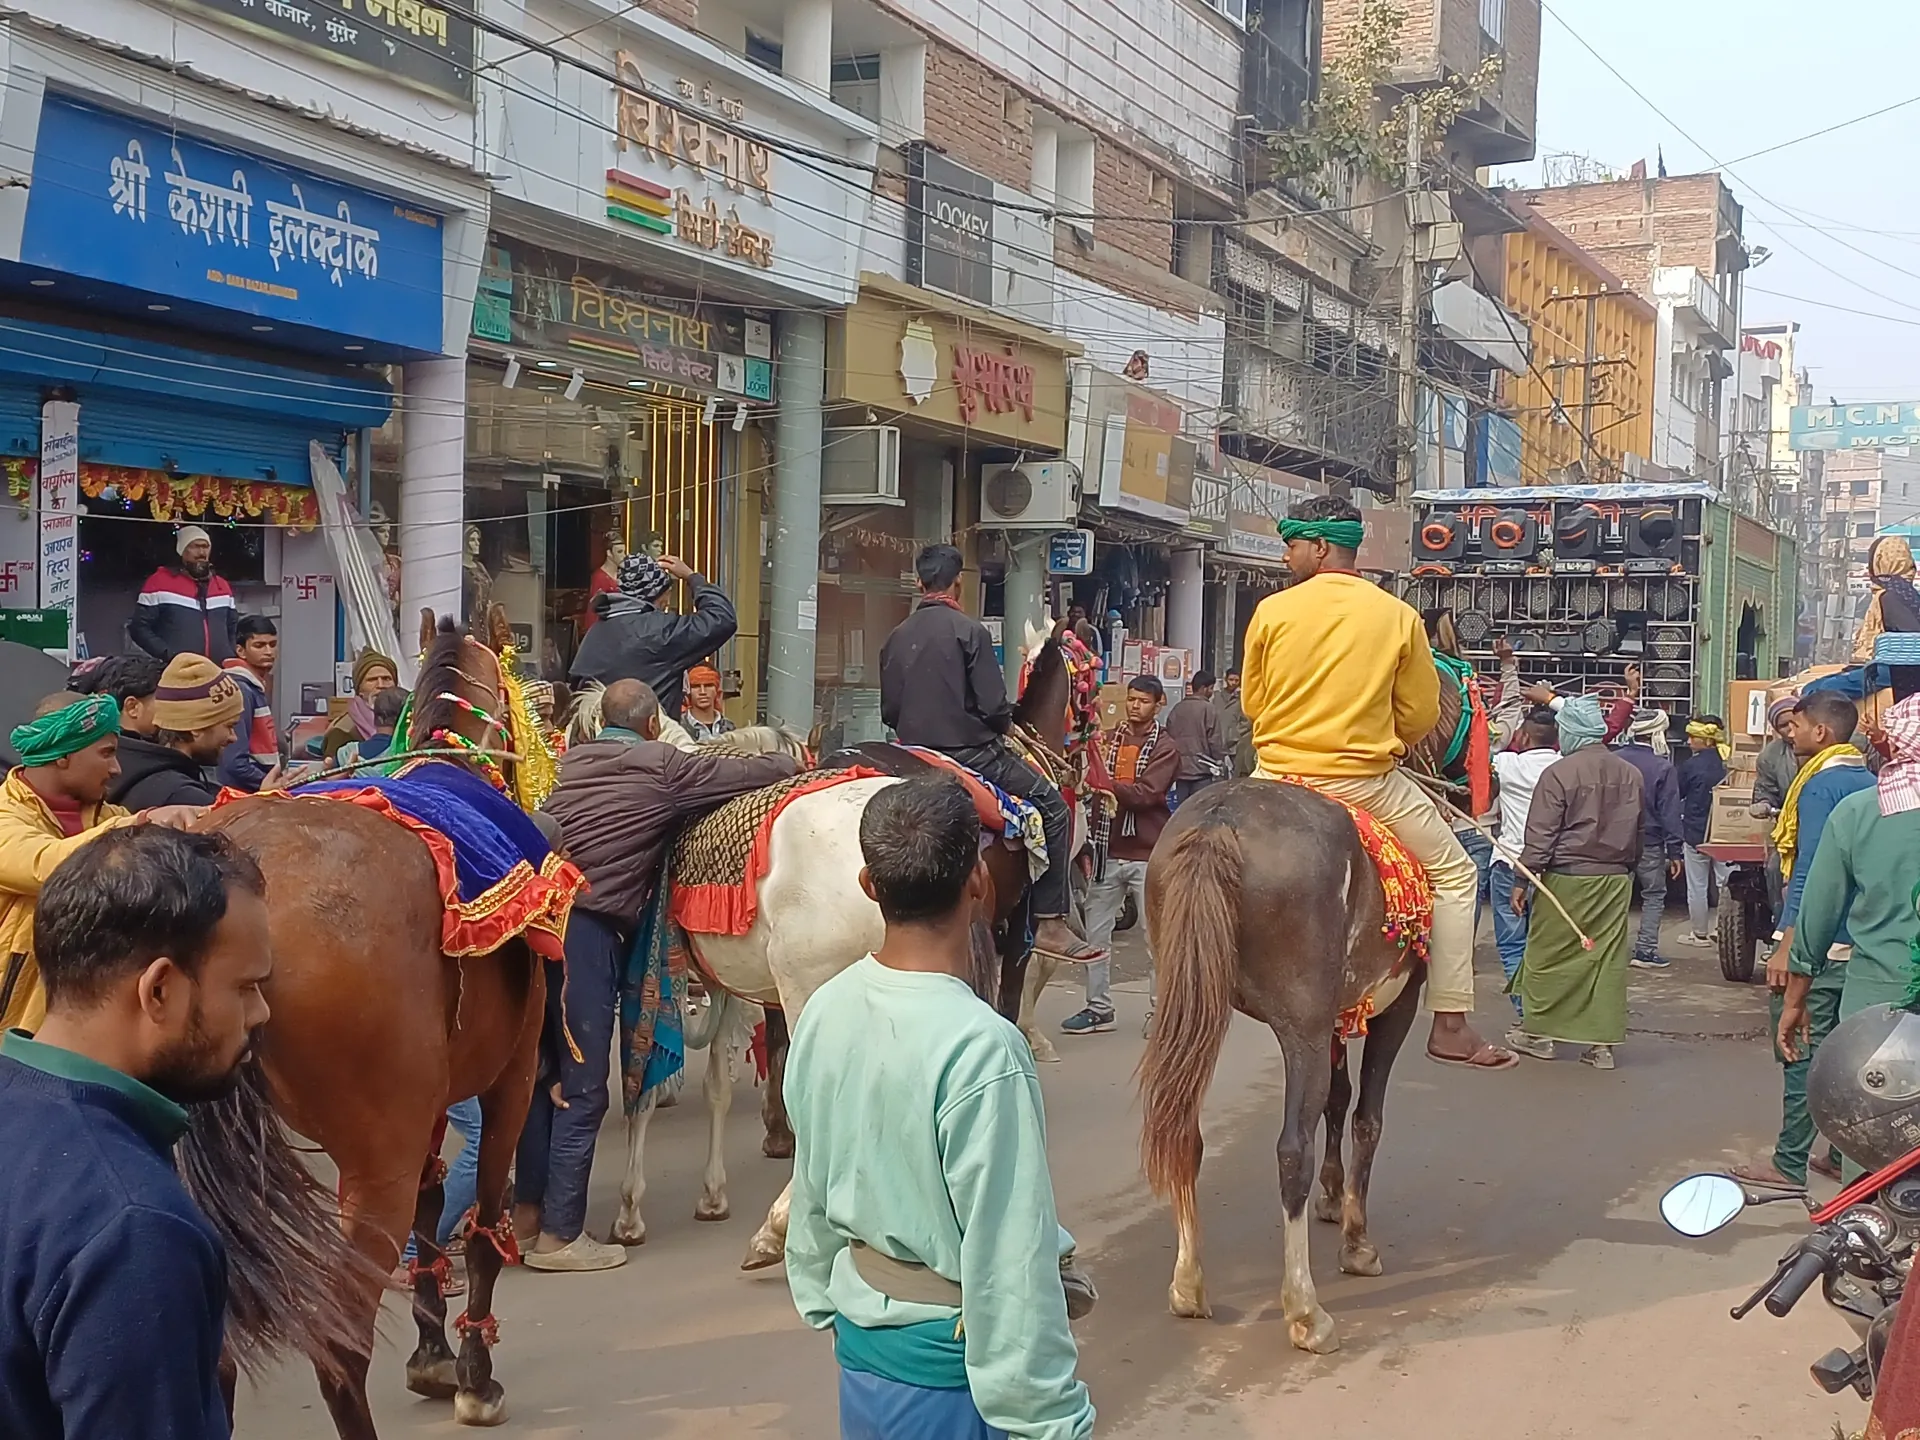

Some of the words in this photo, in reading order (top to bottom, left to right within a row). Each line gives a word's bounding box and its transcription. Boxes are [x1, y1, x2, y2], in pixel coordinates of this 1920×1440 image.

[615, 49, 773, 208] विश्वनाथ
[108, 139, 150, 223] श्री
[164, 149, 253, 250] केशरी
[929, 200, 989, 242] JOCKEY
[571, 276, 713, 351] विश्वनाथ
[51, 497, 66, 510] का
